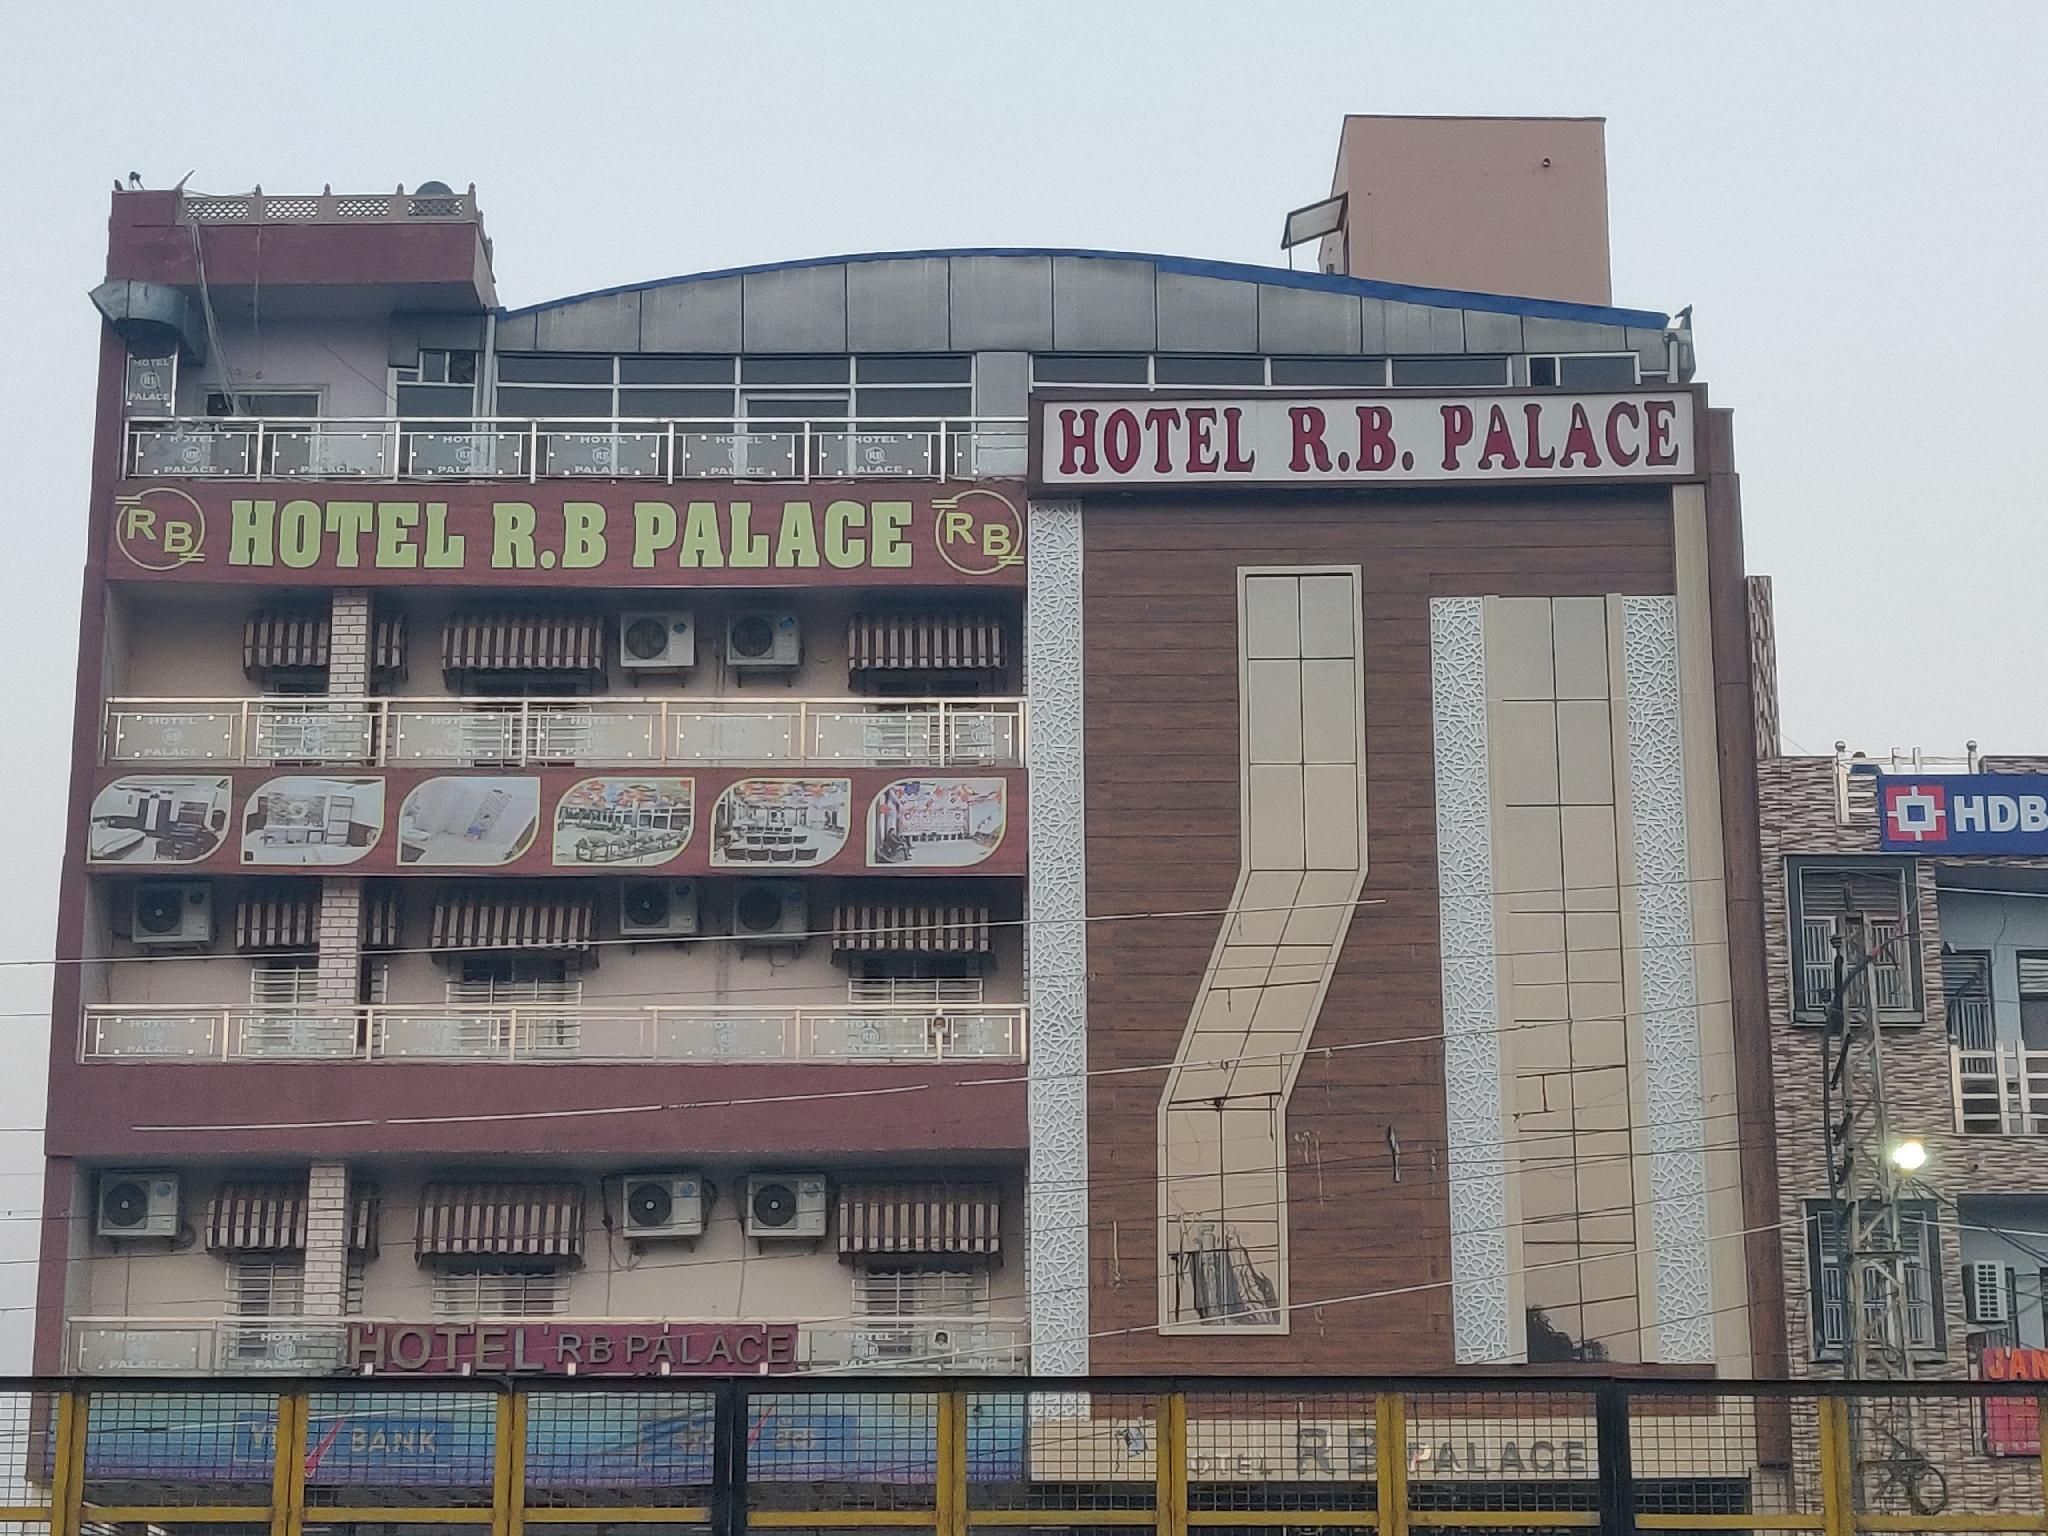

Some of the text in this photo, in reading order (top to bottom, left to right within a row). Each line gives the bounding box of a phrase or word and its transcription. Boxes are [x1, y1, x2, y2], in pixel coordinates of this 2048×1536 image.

[1059, 405, 1256, 476] HOTEL
[1287, 404, 1415, 473] R.B.
[1440, 399, 1680, 472] PALACE
[163, 465, 218, 473] PALACE
[854, 465, 903, 474] ALACE
[229, 499, 914, 569] HOTEL R.B PALACE
[346, 1325, 792, 1372] HOTEL RB PALACE
[351, 1427, 436, 1453] BANK
[1190, 1454, 1272, 1476] OTEL
[1405, 1439, 1586, 1473] PALACE
